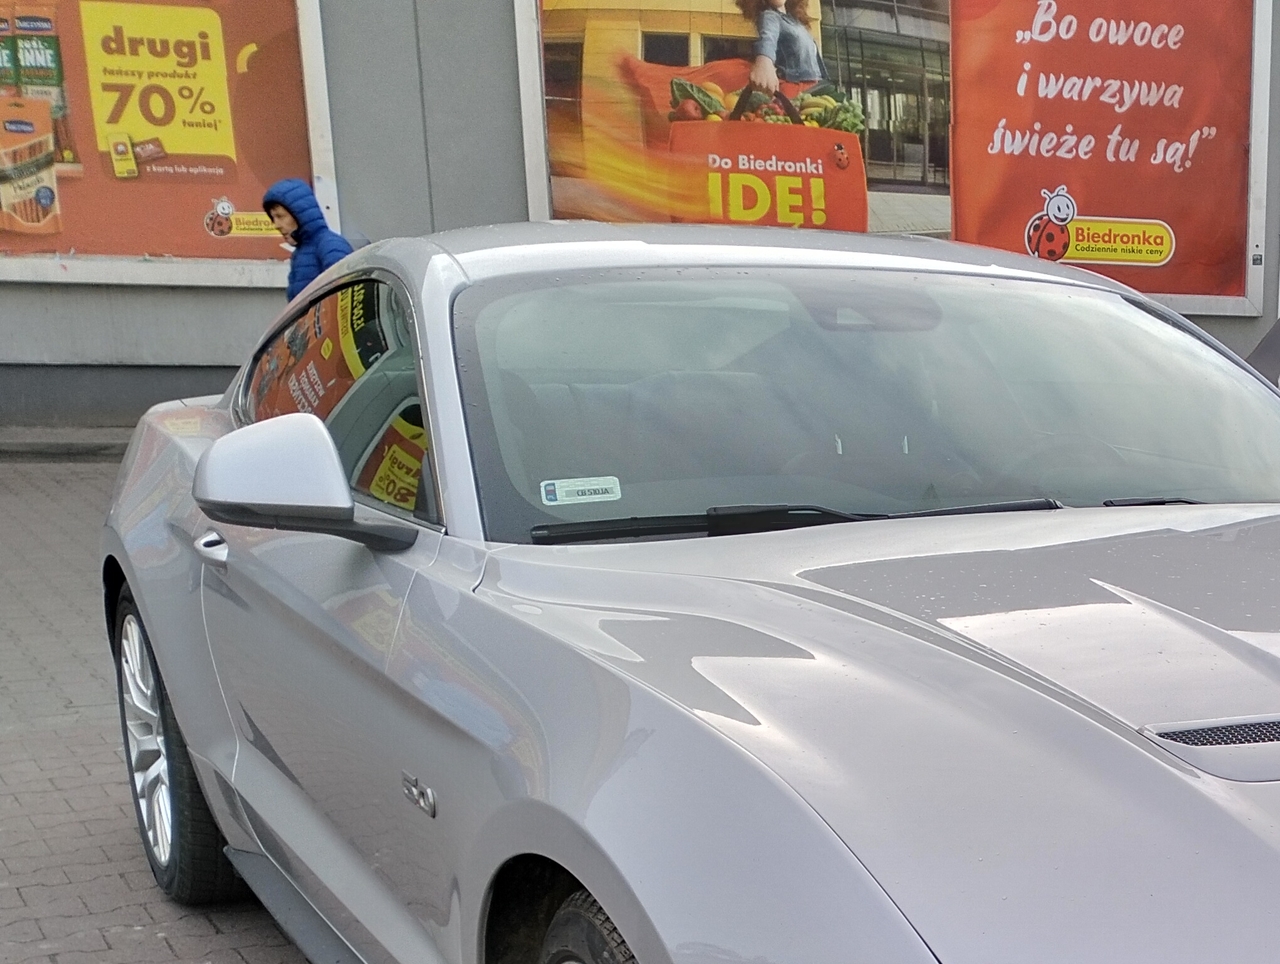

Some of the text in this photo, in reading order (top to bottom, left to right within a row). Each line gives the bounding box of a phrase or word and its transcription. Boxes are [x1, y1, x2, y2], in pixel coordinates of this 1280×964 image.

[1089, 17, 1185, 50] owoce
[101, 25, 212, 68] drugi
[18, 49, 57, 68] INNE
[147, 70, 198, 80] produkt
[1017, 62, 1185, 113] i warzywa
[101, 82, 216, 127] 70%
[987, 118, 1094, 160] świeże
[1106, 123, 1140, 163] tu
[175, 164, 188, 173] lub
[707, 154, 824, 174] Do Biedronki
[707, 172, 827, 228] IDĘ!
[234, 216, 275, 227] Biedro
[1075, 226, 1165, 247] Biedronka
[1074, 243, 1164, 257] Codziennie niskie ceny
